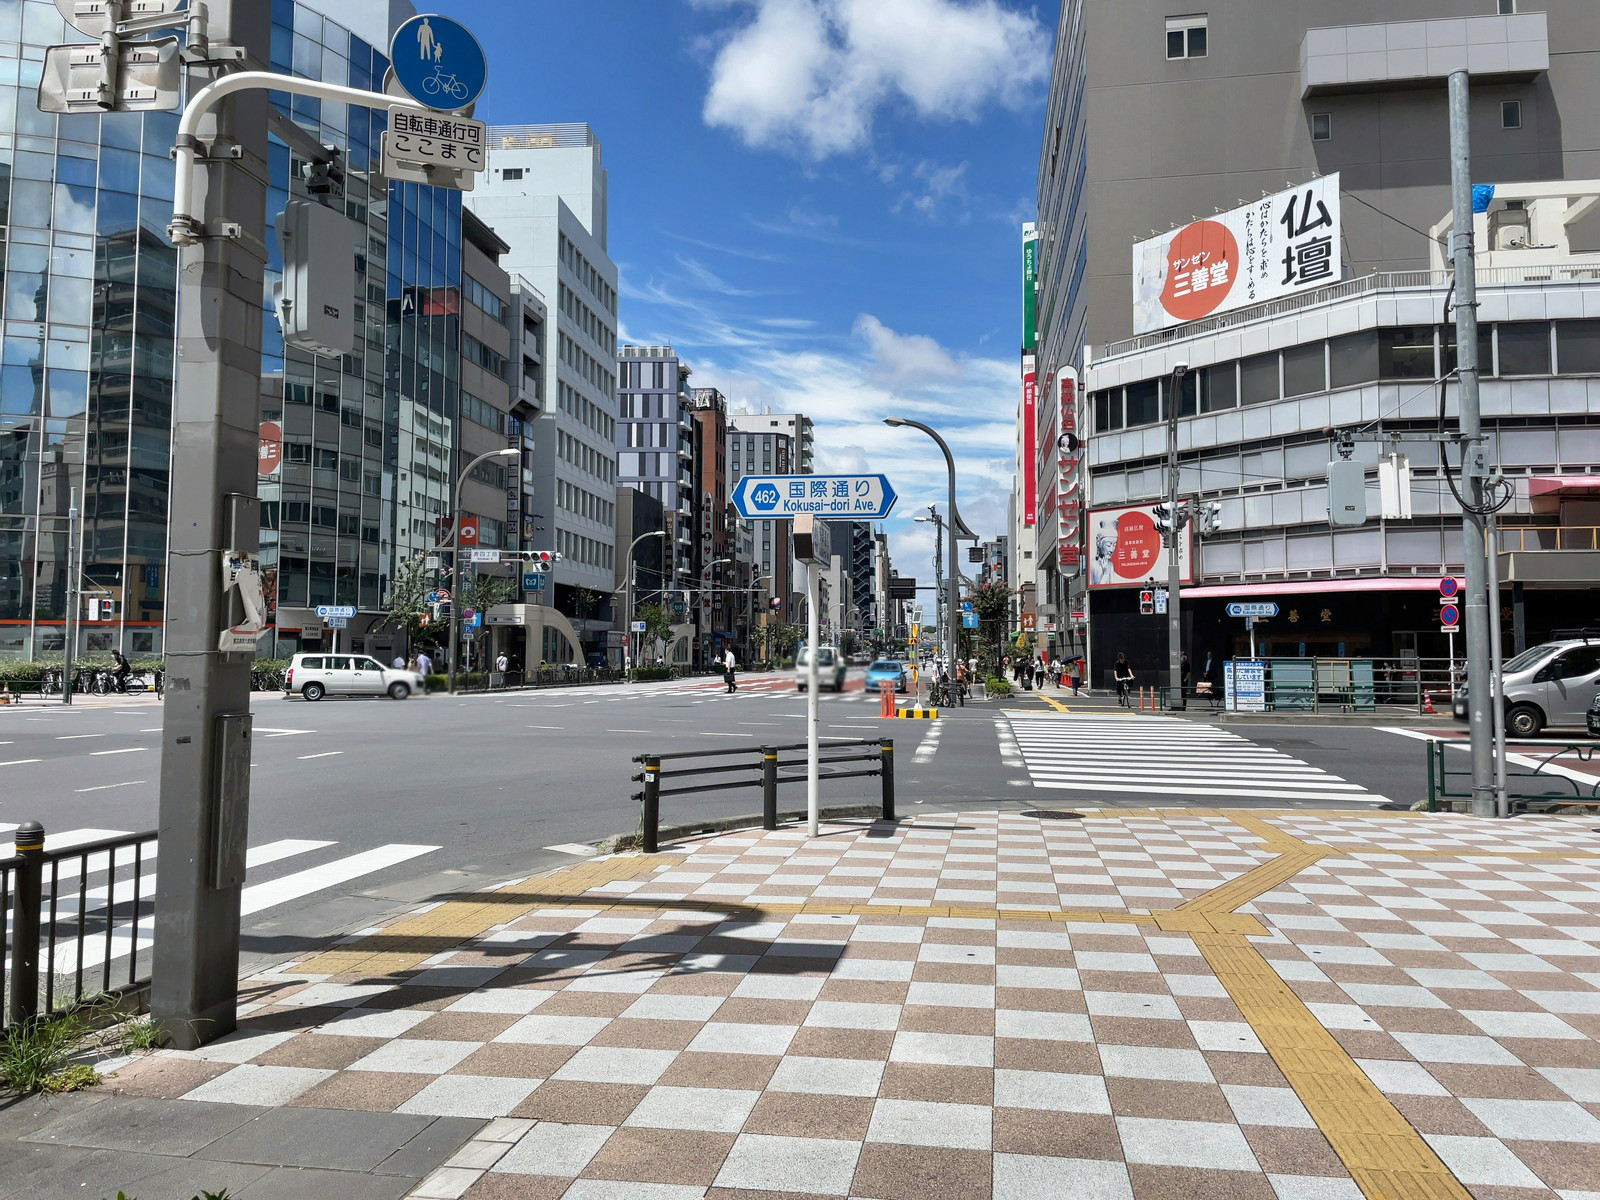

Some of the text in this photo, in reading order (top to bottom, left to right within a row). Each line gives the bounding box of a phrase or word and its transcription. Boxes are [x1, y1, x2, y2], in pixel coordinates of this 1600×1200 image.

[394, 113, 481, 142] 自転車通行可
[395, 134, 480, 164] ここまで
[1280, 189, 1334, 287] 仏壇
[1172, 251, 1211, 272] サンゼン
[1173, 260, 1229, 298] 三善堂
[1060, 377, 1075, 432] 高級仏壇
[755, 480, 870, 504] 462 国際通り
[783, 499, 877, 512] Kokusai-dori Ave.
[1058, 456, 1079, 565] サンゼン堂
